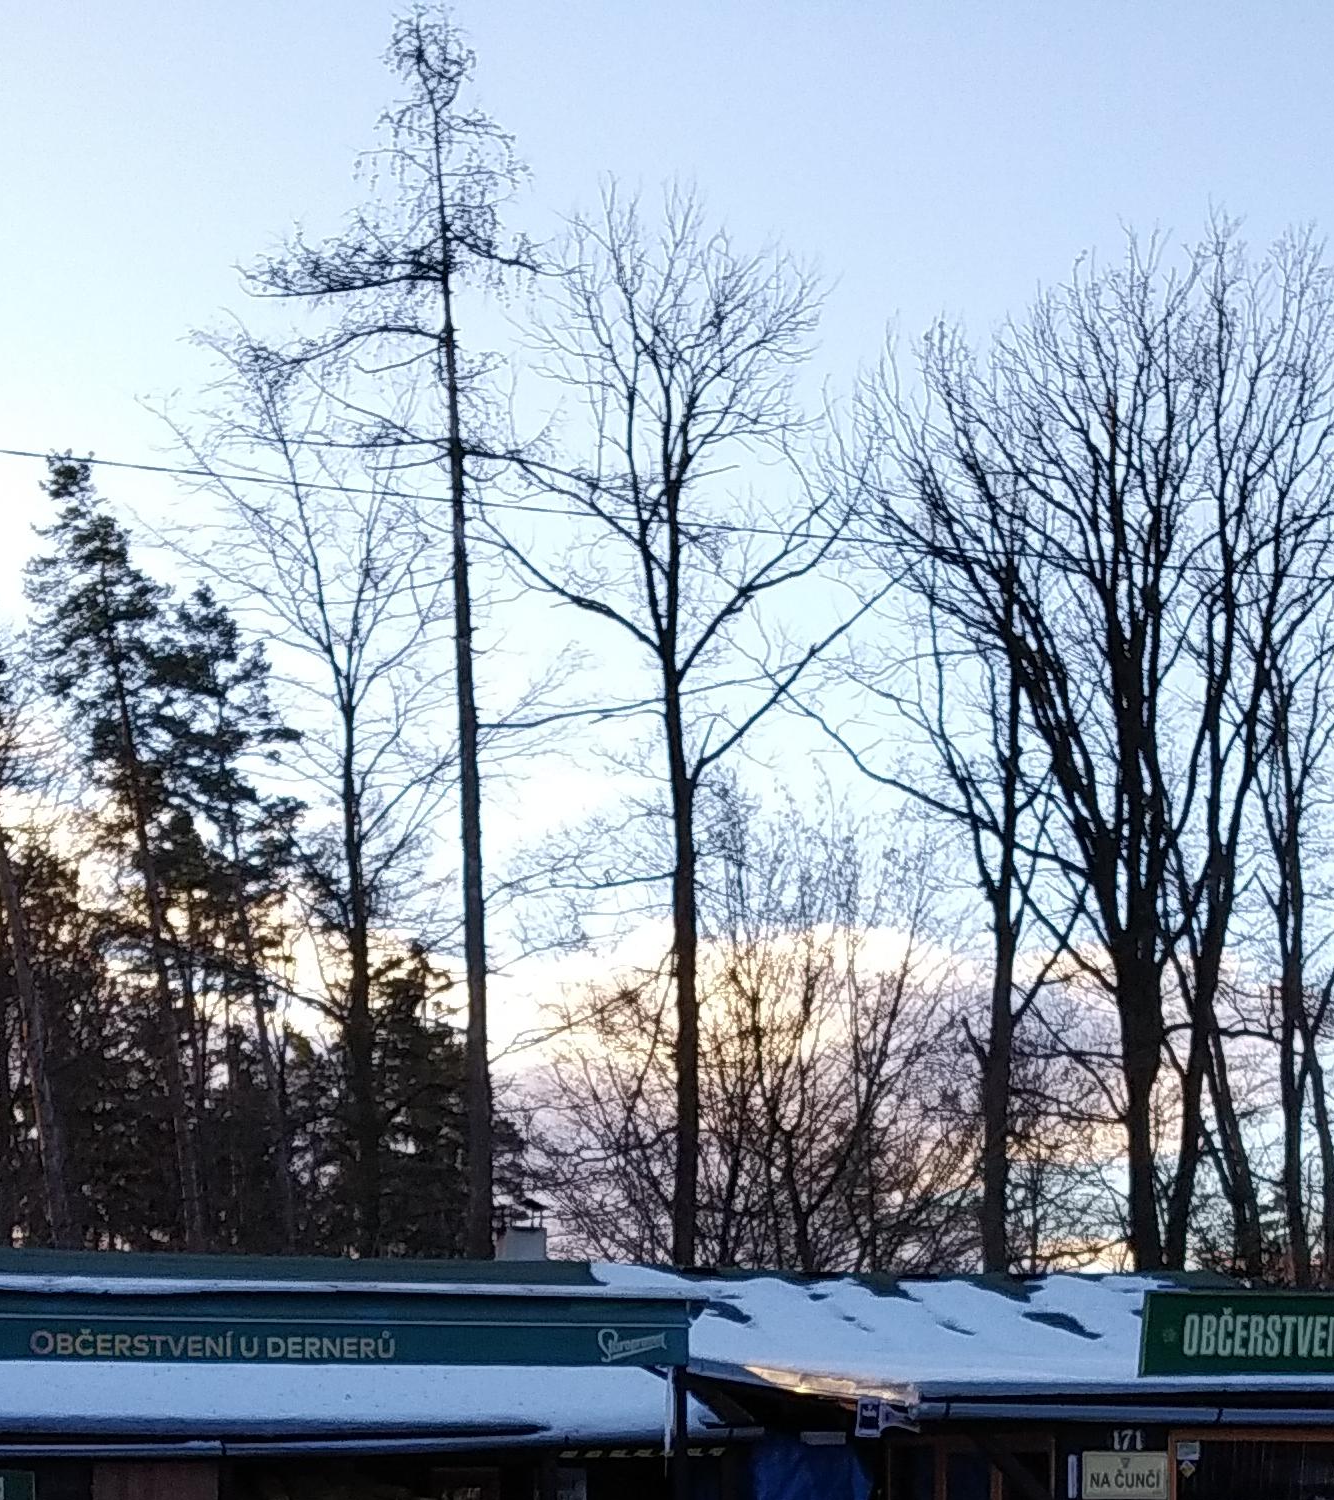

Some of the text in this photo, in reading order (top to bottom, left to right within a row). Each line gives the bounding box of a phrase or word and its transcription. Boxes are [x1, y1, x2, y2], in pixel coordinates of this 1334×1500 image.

[29, 1329, 396, 1359] OBČERSTVENÍ U DERNERŮ
[598, 1328, 667, 1362] Staropra
[1113, 1429, 1144, 1450] 171
[1090, 1468, 1161, 1489] NA ČUNČÍ
